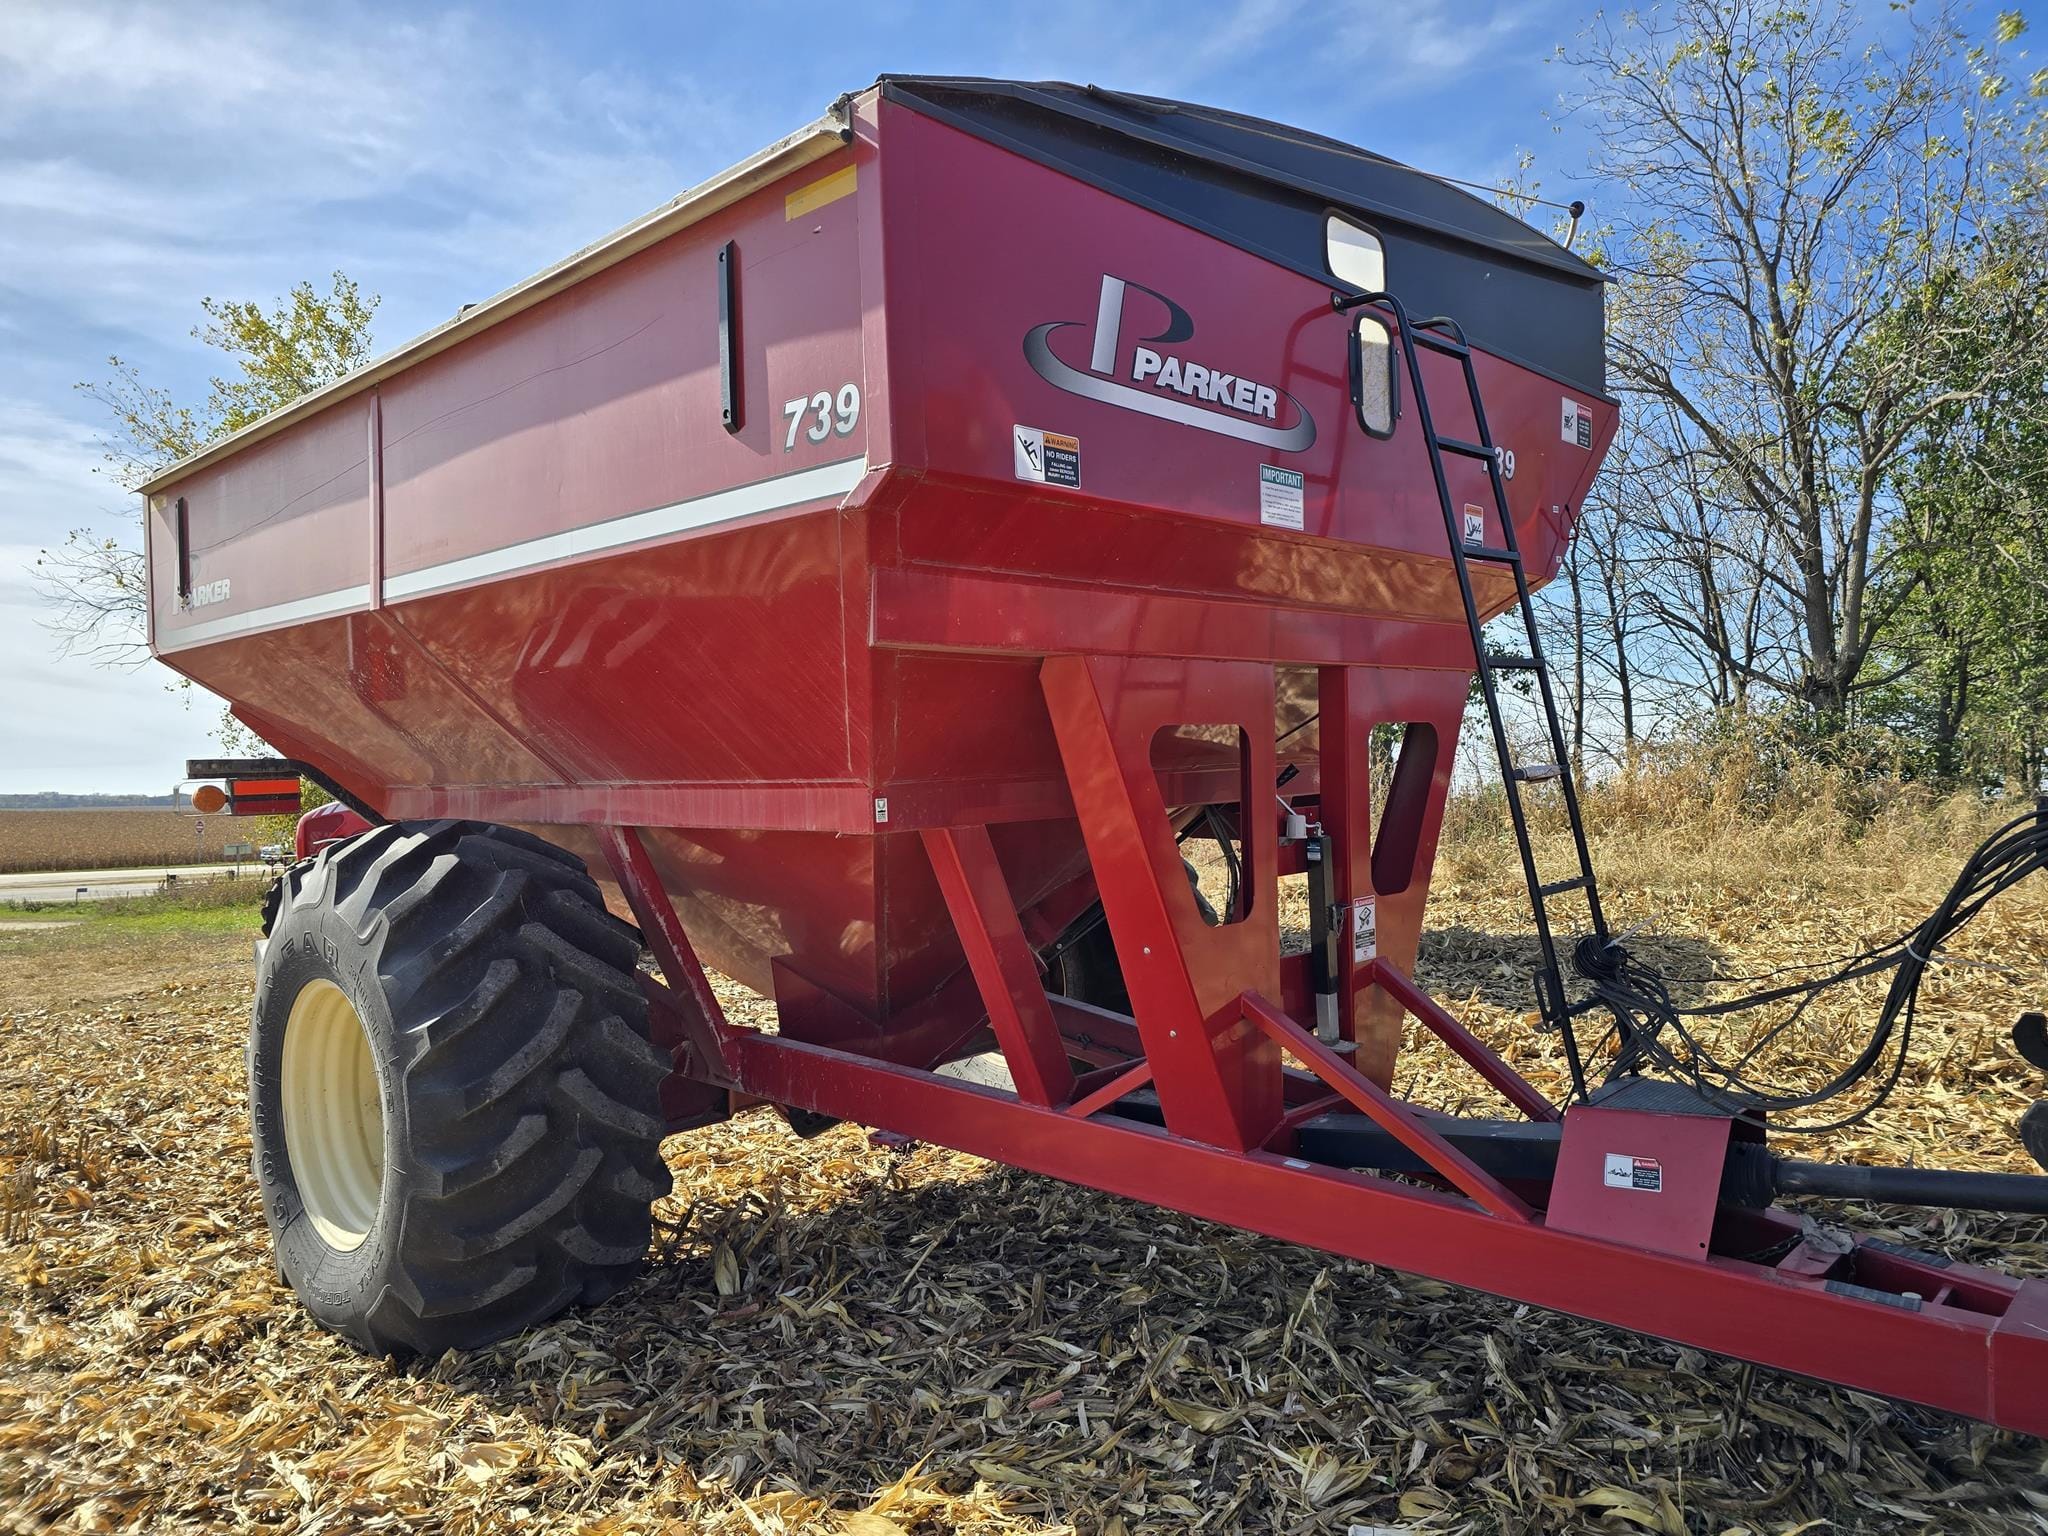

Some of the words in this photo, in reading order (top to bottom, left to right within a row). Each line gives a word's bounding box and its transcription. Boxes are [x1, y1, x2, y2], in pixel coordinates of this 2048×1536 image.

[1132, 345, 1278, 421] PARKER
[783, 382, 860, 450] 739
[1046, 450, 1055, 459] NO
[1056, 452, 1076, 463] RIDERS
[1051, 438, 1077, 449] WARNING
[1262, 467, 1302, 488] IMPORTANT
[186, 578, 231, 609] ARKER
